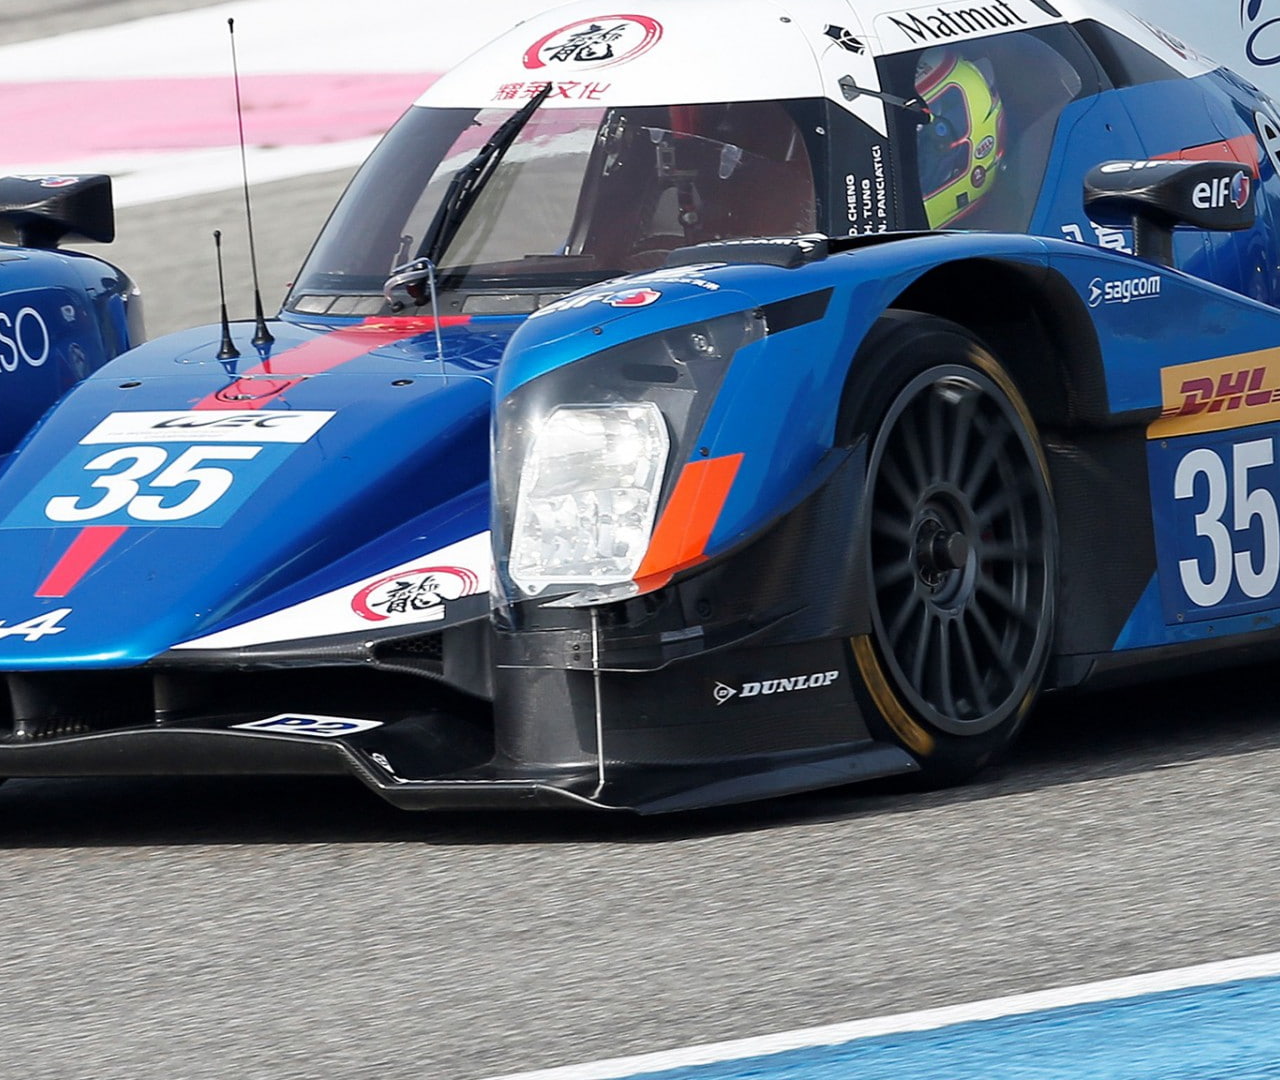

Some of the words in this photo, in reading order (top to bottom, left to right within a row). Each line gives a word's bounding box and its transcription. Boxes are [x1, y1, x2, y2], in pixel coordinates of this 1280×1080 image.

[845, 174, 858, 221] CHENG
[861, 179, 873, 218] TUNG
[871, 145, 888, 218] PANCIATICI
[1192, 176, 1231, 209] elf
[1104, 275, 1161, 303] sagcom
[1179, 366, 1273, 417] DHL
[44, 445, 264, 522] 35
[1173, 437, 1280, 608] 35
[738, 670, 840, 698] DUNLOP
